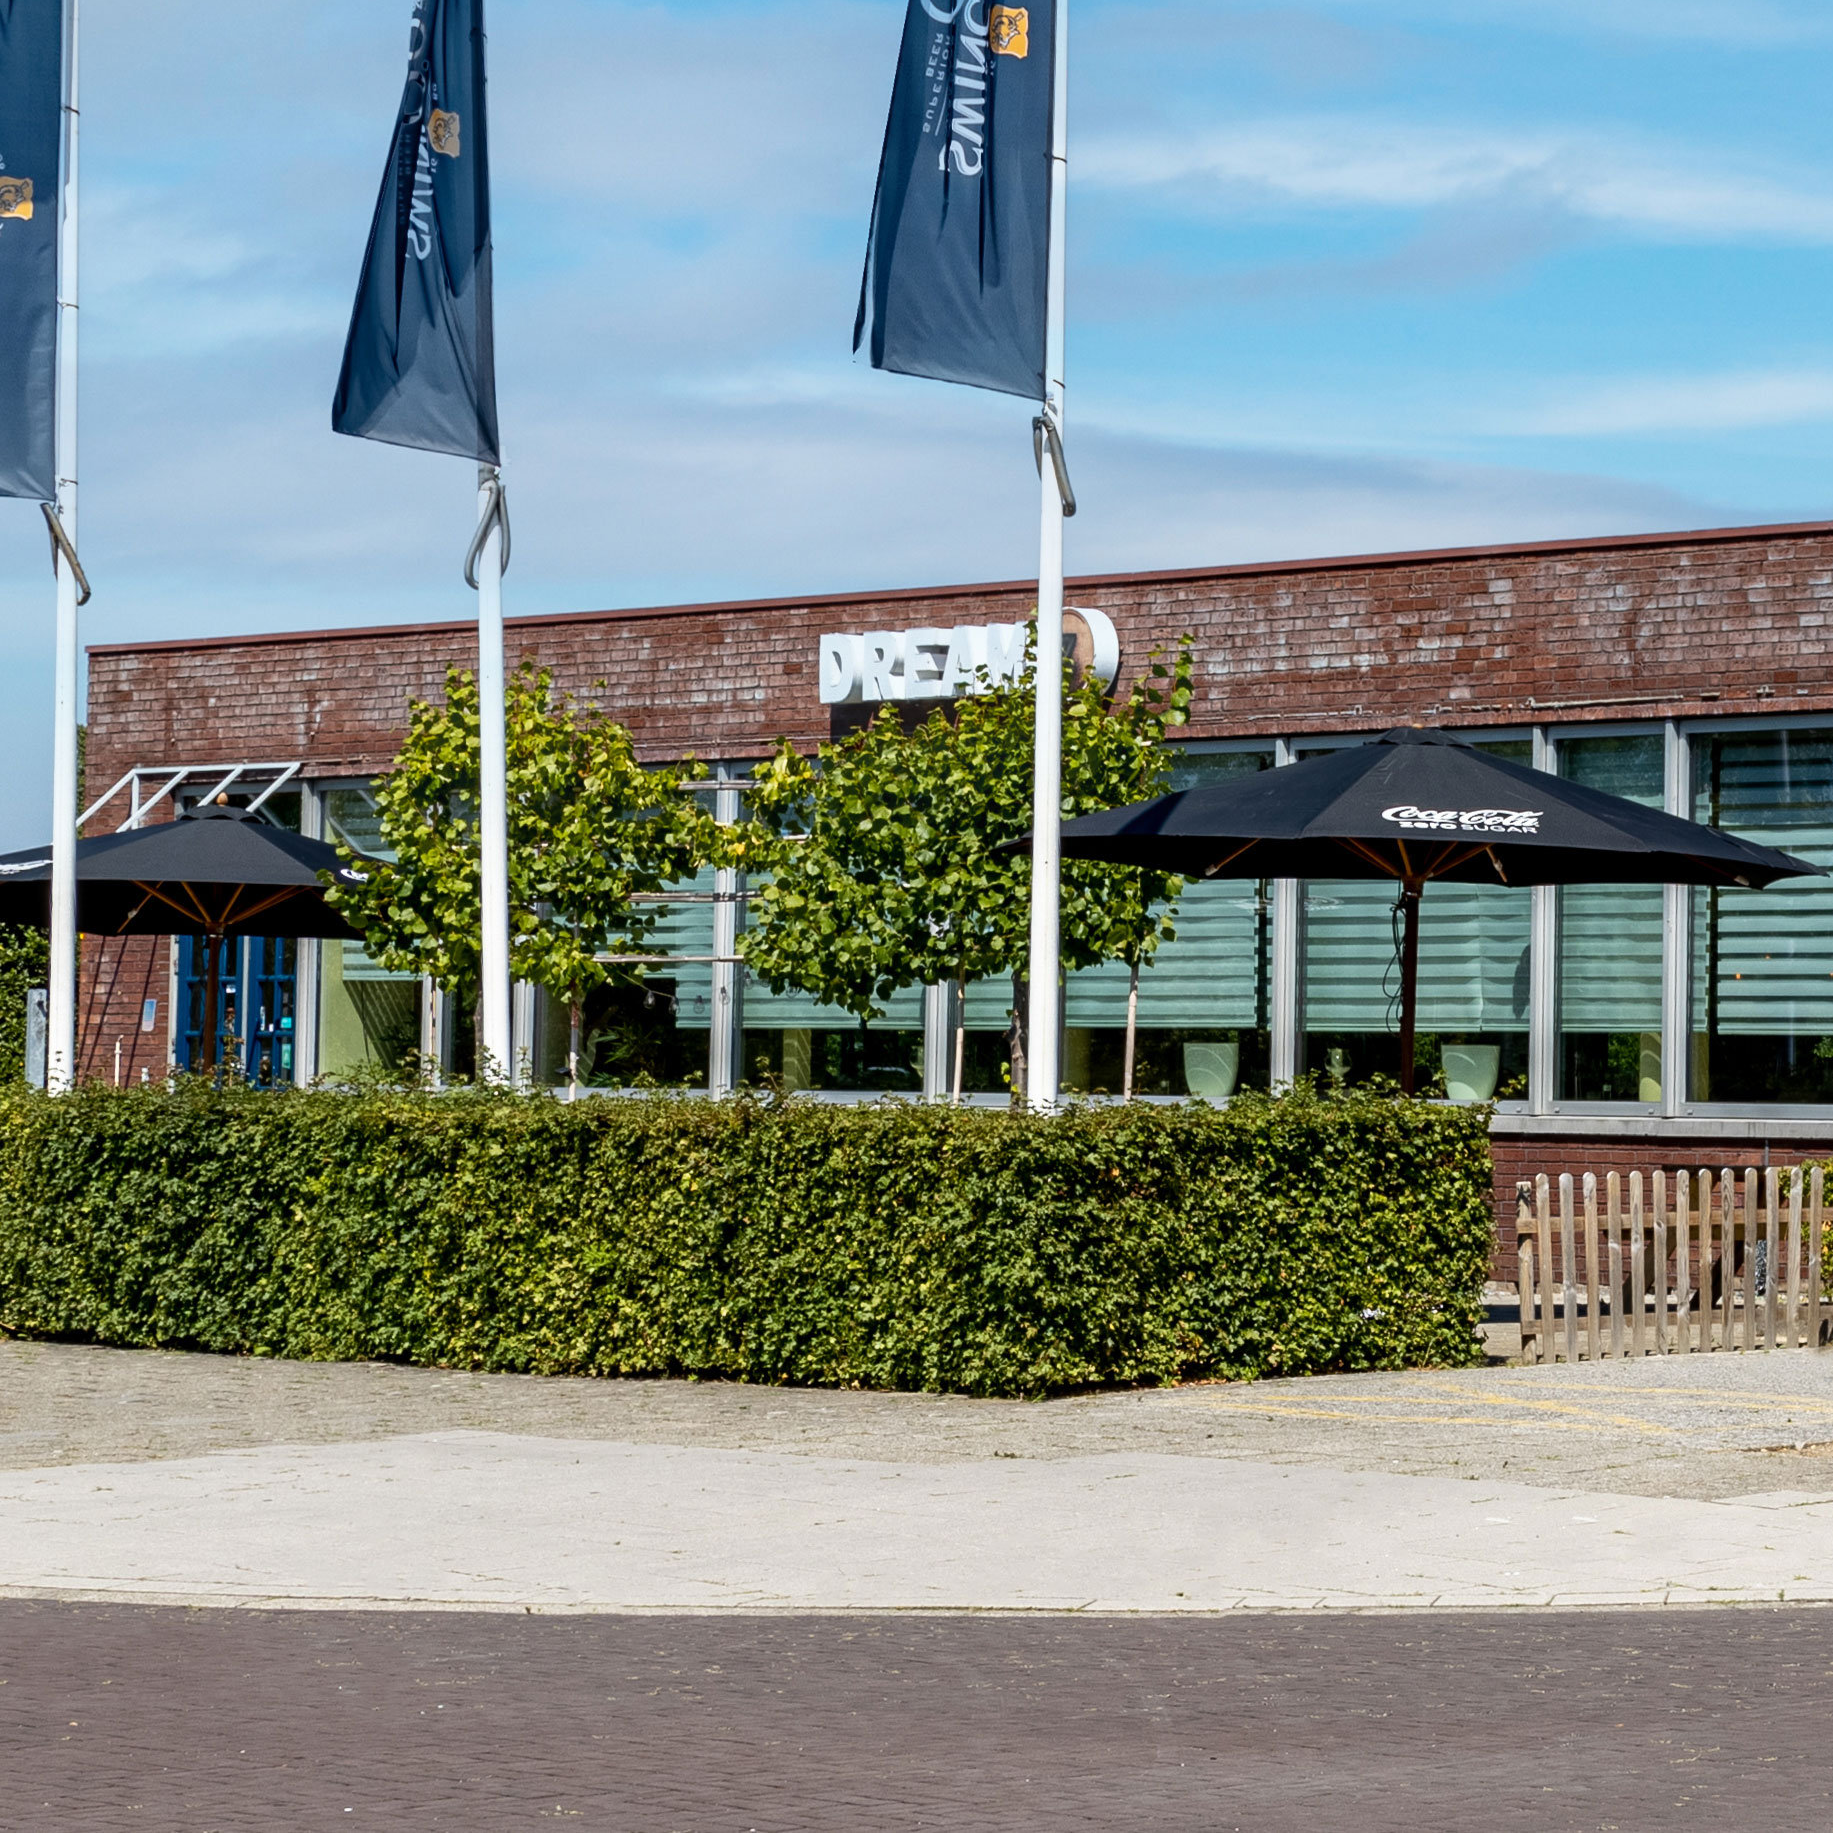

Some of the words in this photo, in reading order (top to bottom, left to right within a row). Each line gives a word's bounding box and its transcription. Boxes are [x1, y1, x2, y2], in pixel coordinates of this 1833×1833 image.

[820, 621, 1037, 703] DREAM
[1381, 805, 1544, 828] Coca-Cola
[1460, 824, 1538, 834] SUGAR
